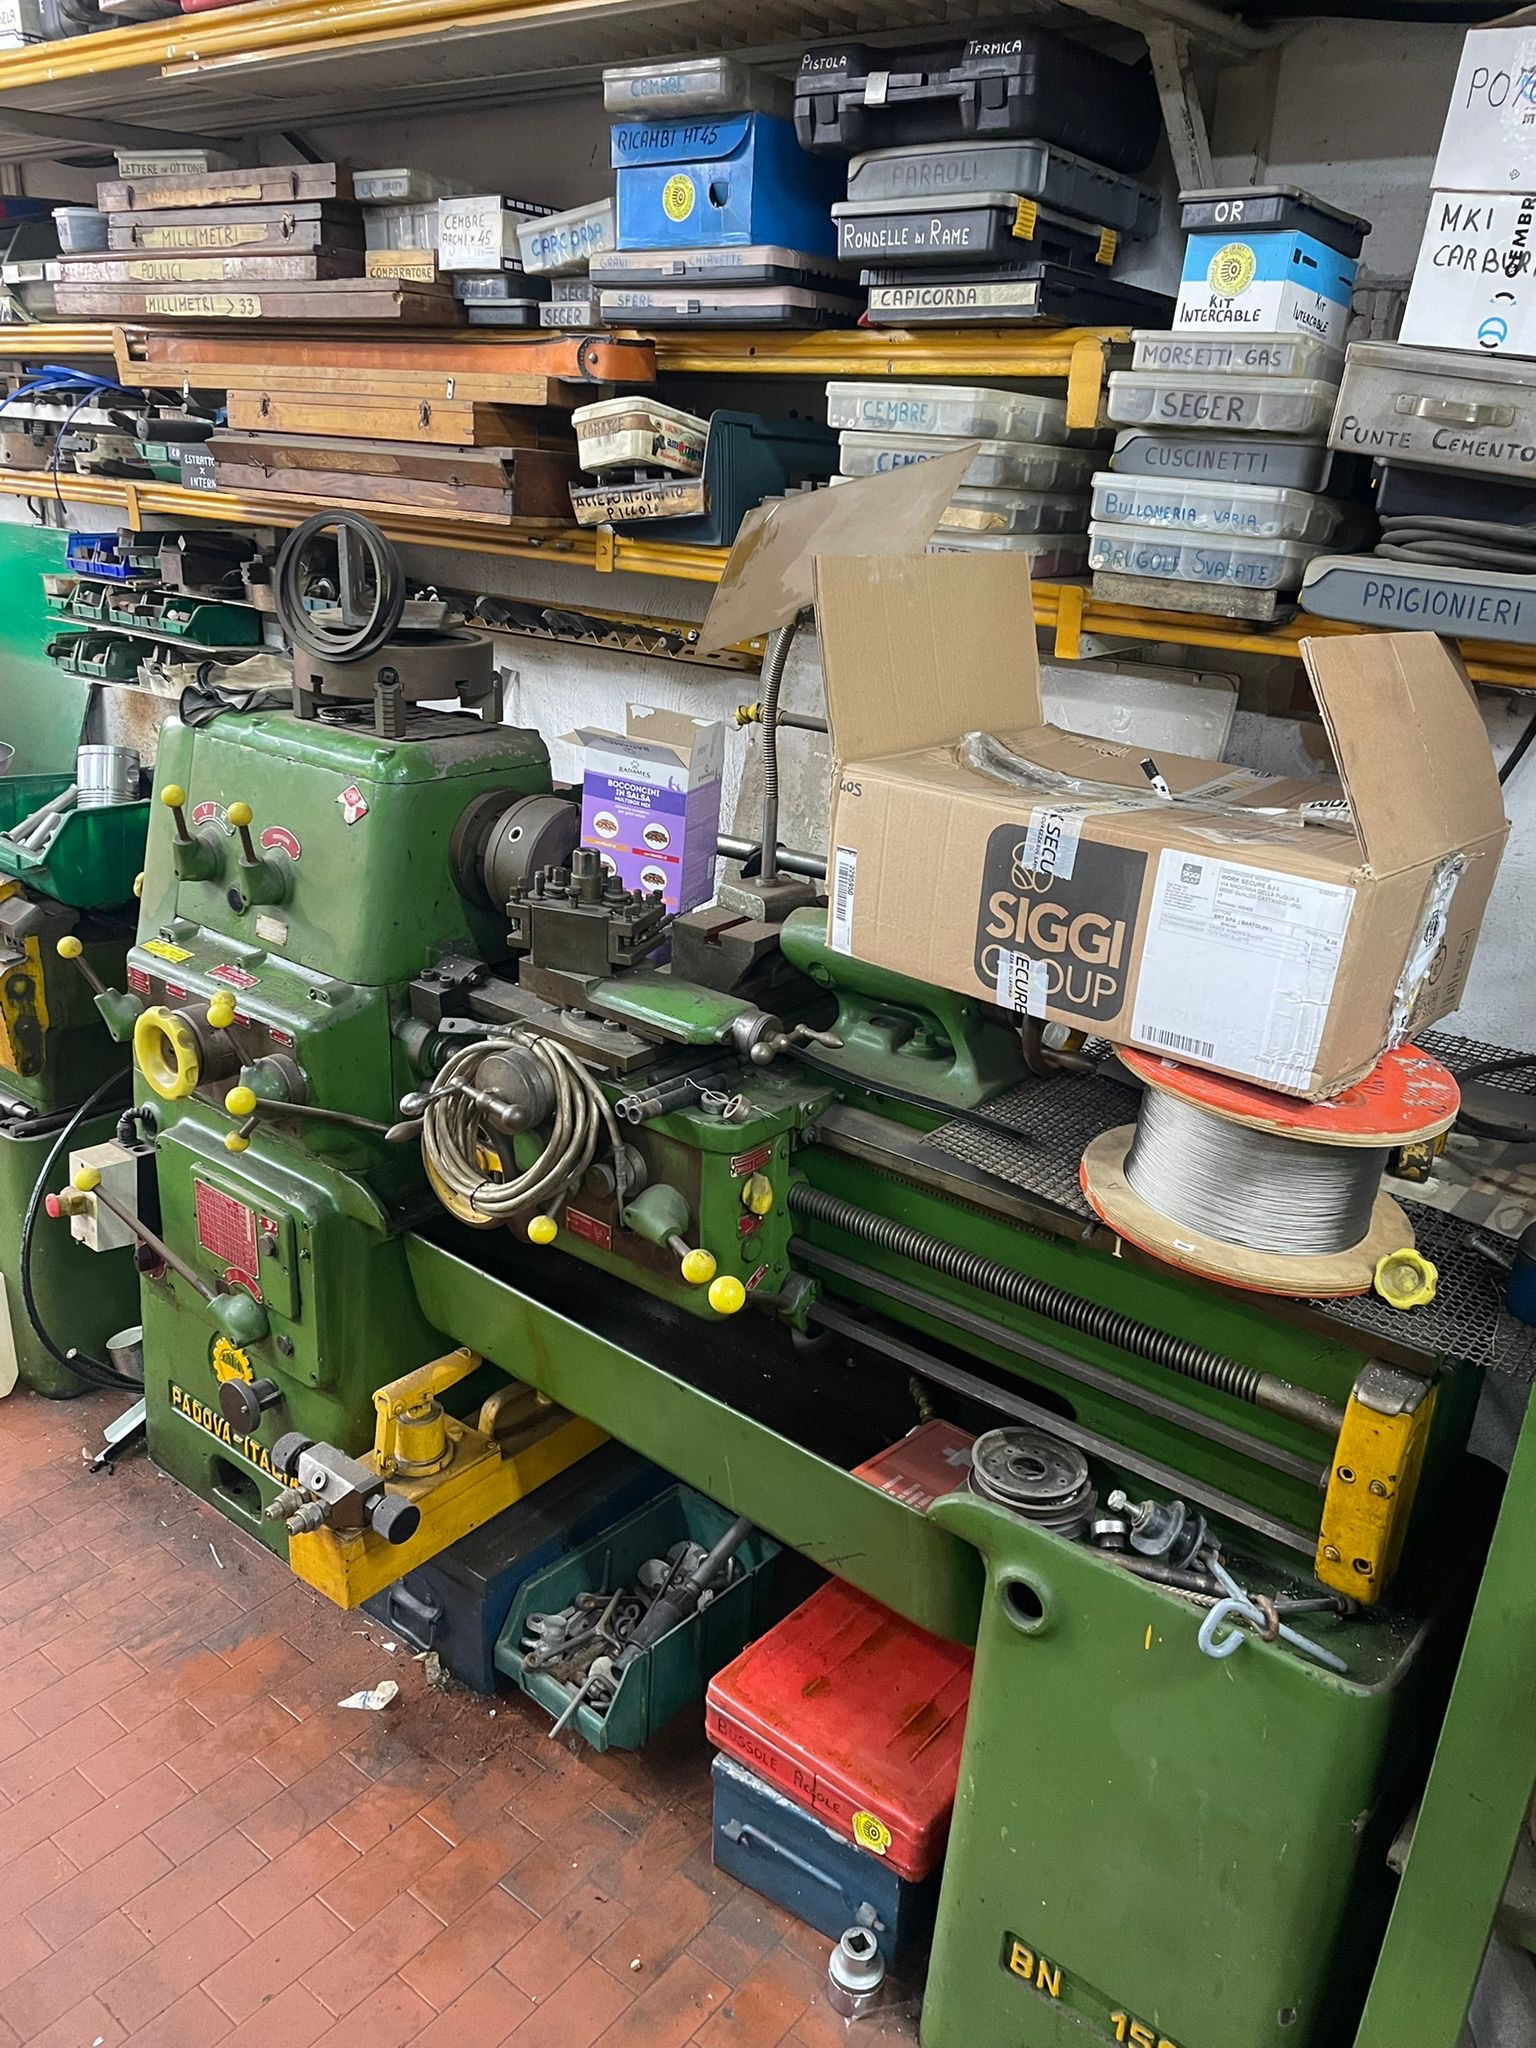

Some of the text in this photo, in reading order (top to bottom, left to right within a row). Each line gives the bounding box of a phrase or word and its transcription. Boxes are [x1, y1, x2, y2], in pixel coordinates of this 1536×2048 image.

[801, 39, 1023, 70] PISTOLA TERMICA
[630, 76, 687, 97] CEMBRE
[617, 125, 720, 151] RICAMBI HT45
[120, 163, 158, 174] LETTERE
[169, 162, 207, 174] OTTONE
[892, 161, 978, 188] PARAOLI
[1214, 200, 1245, 223] OR
[162, 226, 239, 248] MILLIMETRI
[477, 229, 493, 246] 45
[844, 223, 909, 249] RONDELLE
[929, 219, 970, 246] RAME
[141, 262, 183, 279] POLLICI
[688, 254, 743, 267] CHIAVETTE
[370, 267, 432, 279] COMPARATORE
[148, 294, 214, 312] MILLIMETRI
[240, 298, 255, 314] 33
[881, 288, 978, 307] CAPICORDA
[1209, 294, 1235, 309] KIT
[544, 307, 582, 325] SEGER
[1179, 302, 1262, 323] INTERCABLE
[1292, 301, 1330, 333] INTERCABLE
[1142, 344, 1282, 367] MORSETTI GAS
[862, 400, 930, 423] CEMBRE
[1160, 391, 1245, 422] SEGER
[1340, 415, 1536, 463] PUNTE CEMENTO
[1145, 446, 1269, 473] CUSCINETTI
[1105, 492, 1257, 526] BULLONERIA VARIA
[1191, 550, 1270, 582] SVASATE
[1362, 580, 1522, 626] PRIGIONIERI
[607, 778, 660, 797] BOCCONCINI
[615, 788, 652, 803] IN SALSA
[1221, 874, 1240, 883] WORK
[1241, 879, 1266, 890] SECURE
[985, 890, 1126, 970] SIGGI
[980, 943, 1118, 1008] GOUP
[717, 1718, 778, 1772] BUSSOLE
[1010, 1940, 1063, 1999] BN
[1110, 2010, 1178, 2048] 15
